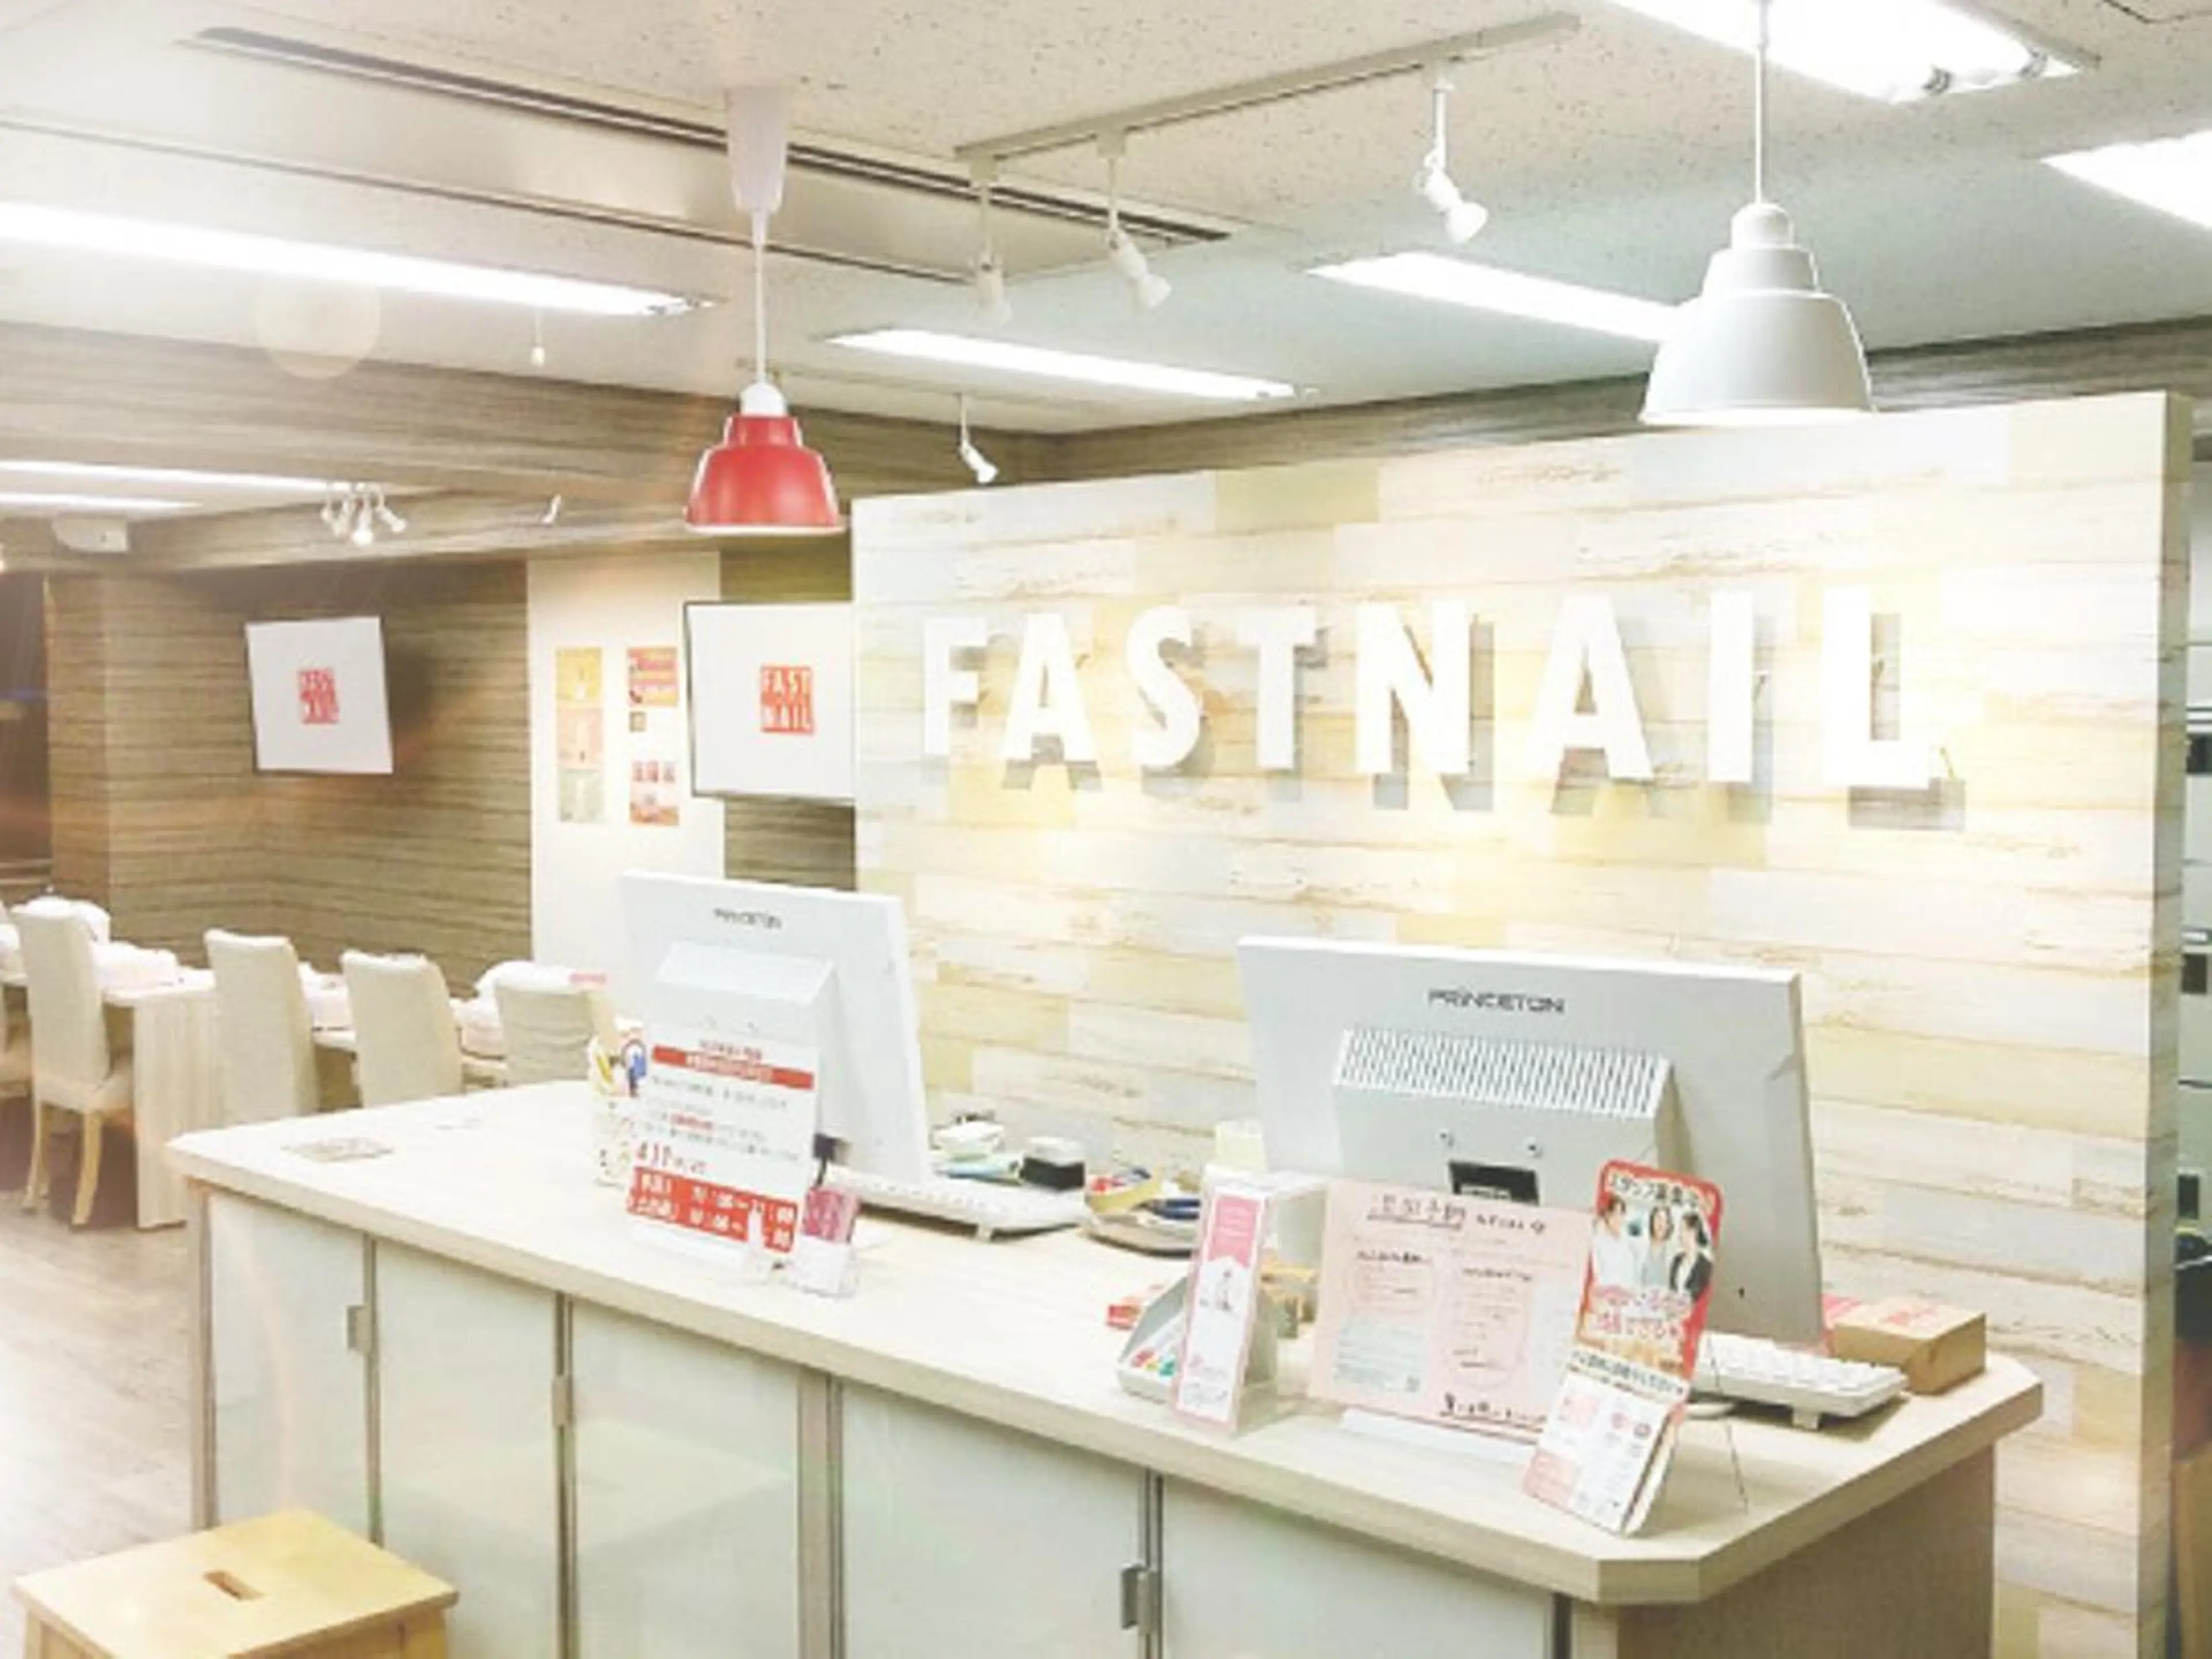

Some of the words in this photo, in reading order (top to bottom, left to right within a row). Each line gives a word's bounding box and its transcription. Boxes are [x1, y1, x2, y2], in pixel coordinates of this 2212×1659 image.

[762, 666, 812, 696] FAST
[923, 588, 1931, 788] FASTNAIL
[762, 698, 815, 733] NAIL
[1427, 988, 1566, 1015] PRINCETON
